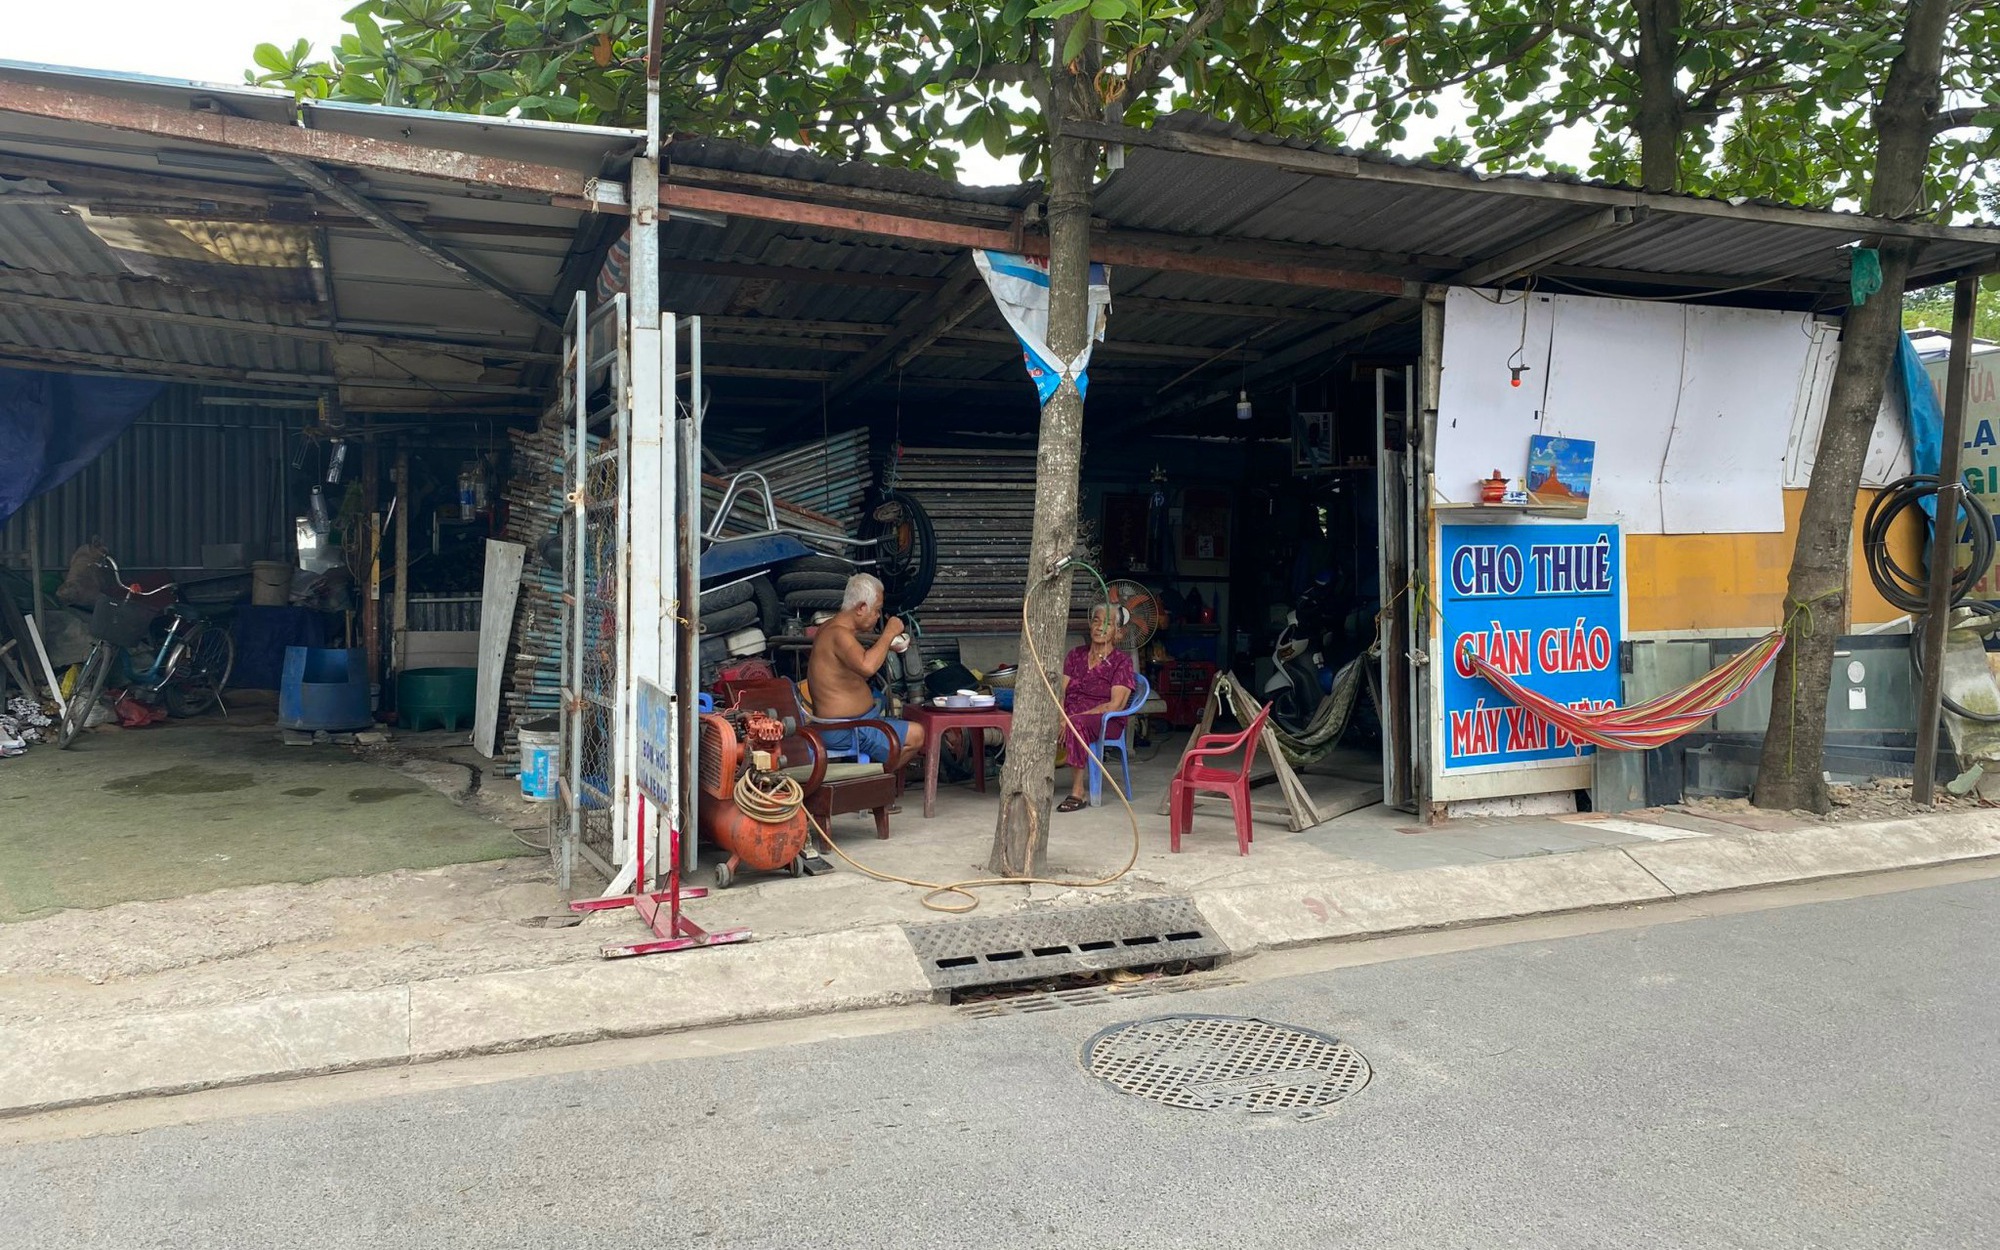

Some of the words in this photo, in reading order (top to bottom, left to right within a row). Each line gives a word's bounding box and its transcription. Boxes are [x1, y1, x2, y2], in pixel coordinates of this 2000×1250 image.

[1451, 545, 1523, 596] CHO
[1530, 533, 1614, 594] THUÊ
[1453, 620, 1532, 678] GIÀN
[1538, 617, 1612, 674] GIÁO
[1449, 698, 1500, 758] MÁY
